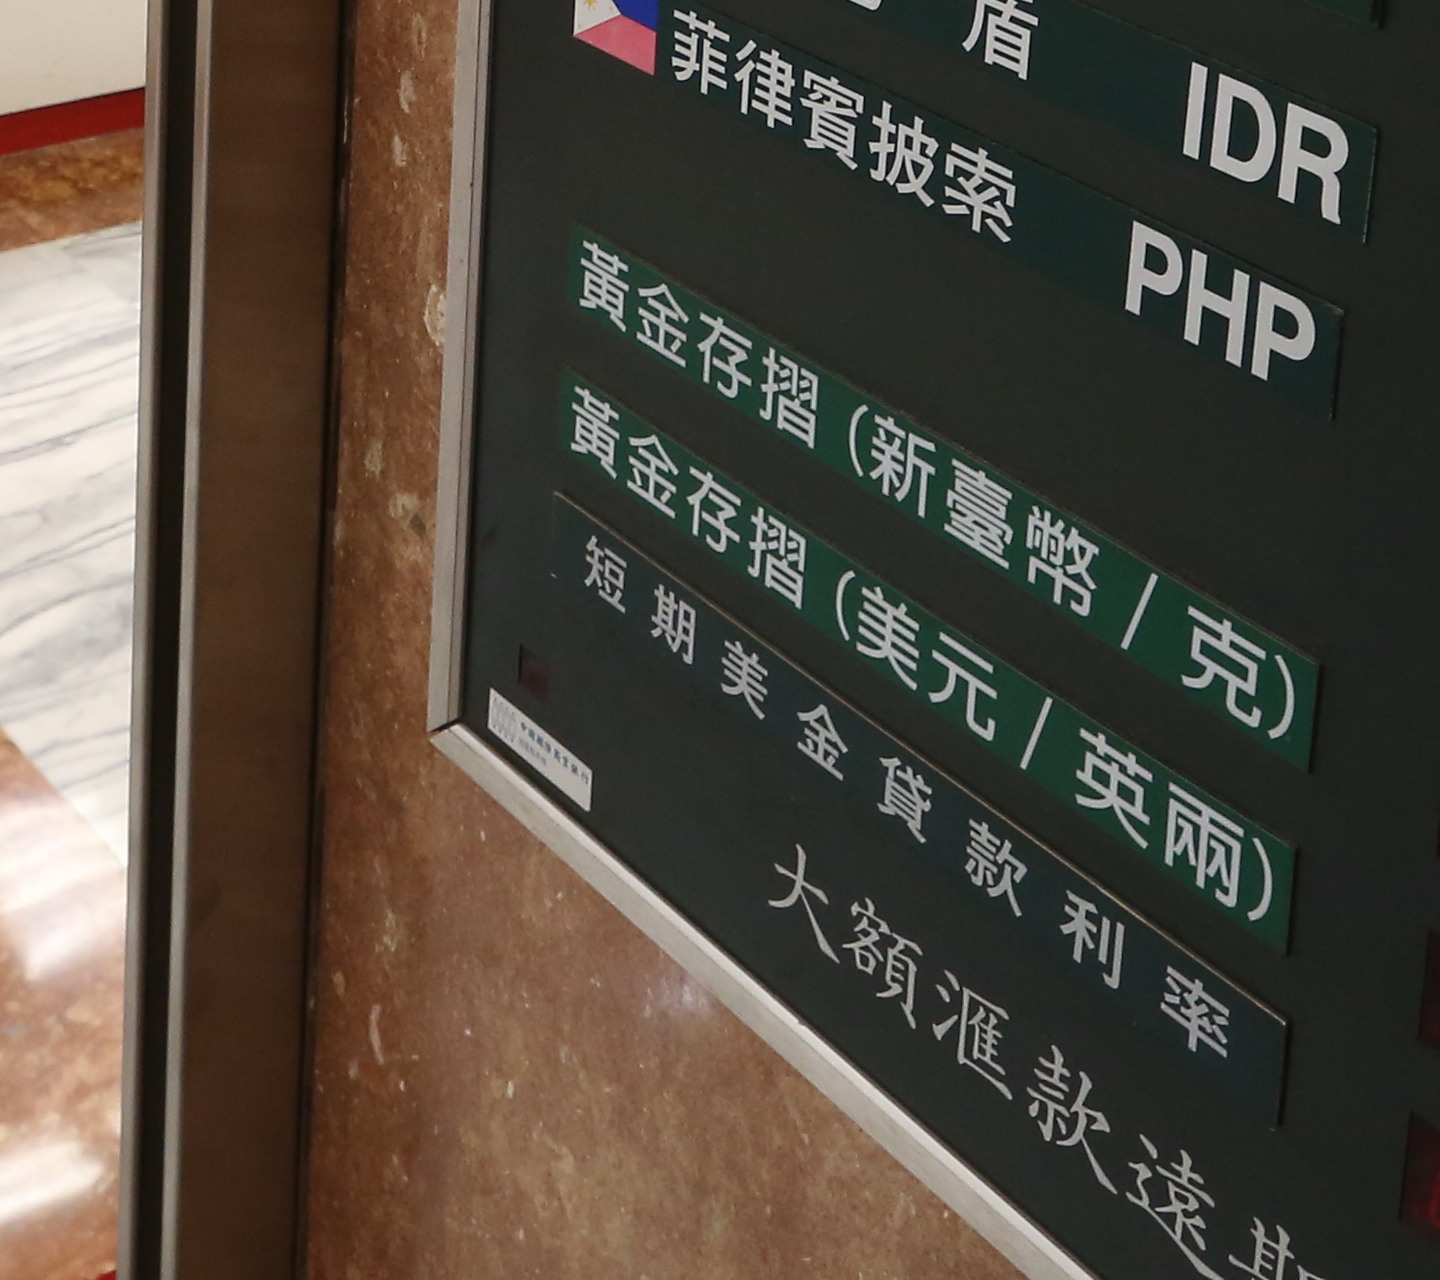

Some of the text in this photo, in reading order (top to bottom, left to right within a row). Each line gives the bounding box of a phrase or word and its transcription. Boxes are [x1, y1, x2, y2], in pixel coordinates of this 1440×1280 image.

[672, 8, 1317, 381] 菲律賓披索 PHP
[1183, 63, 1350, 225] IDR
[584, 535, 1229, 1058] 短期美金貸款利率
